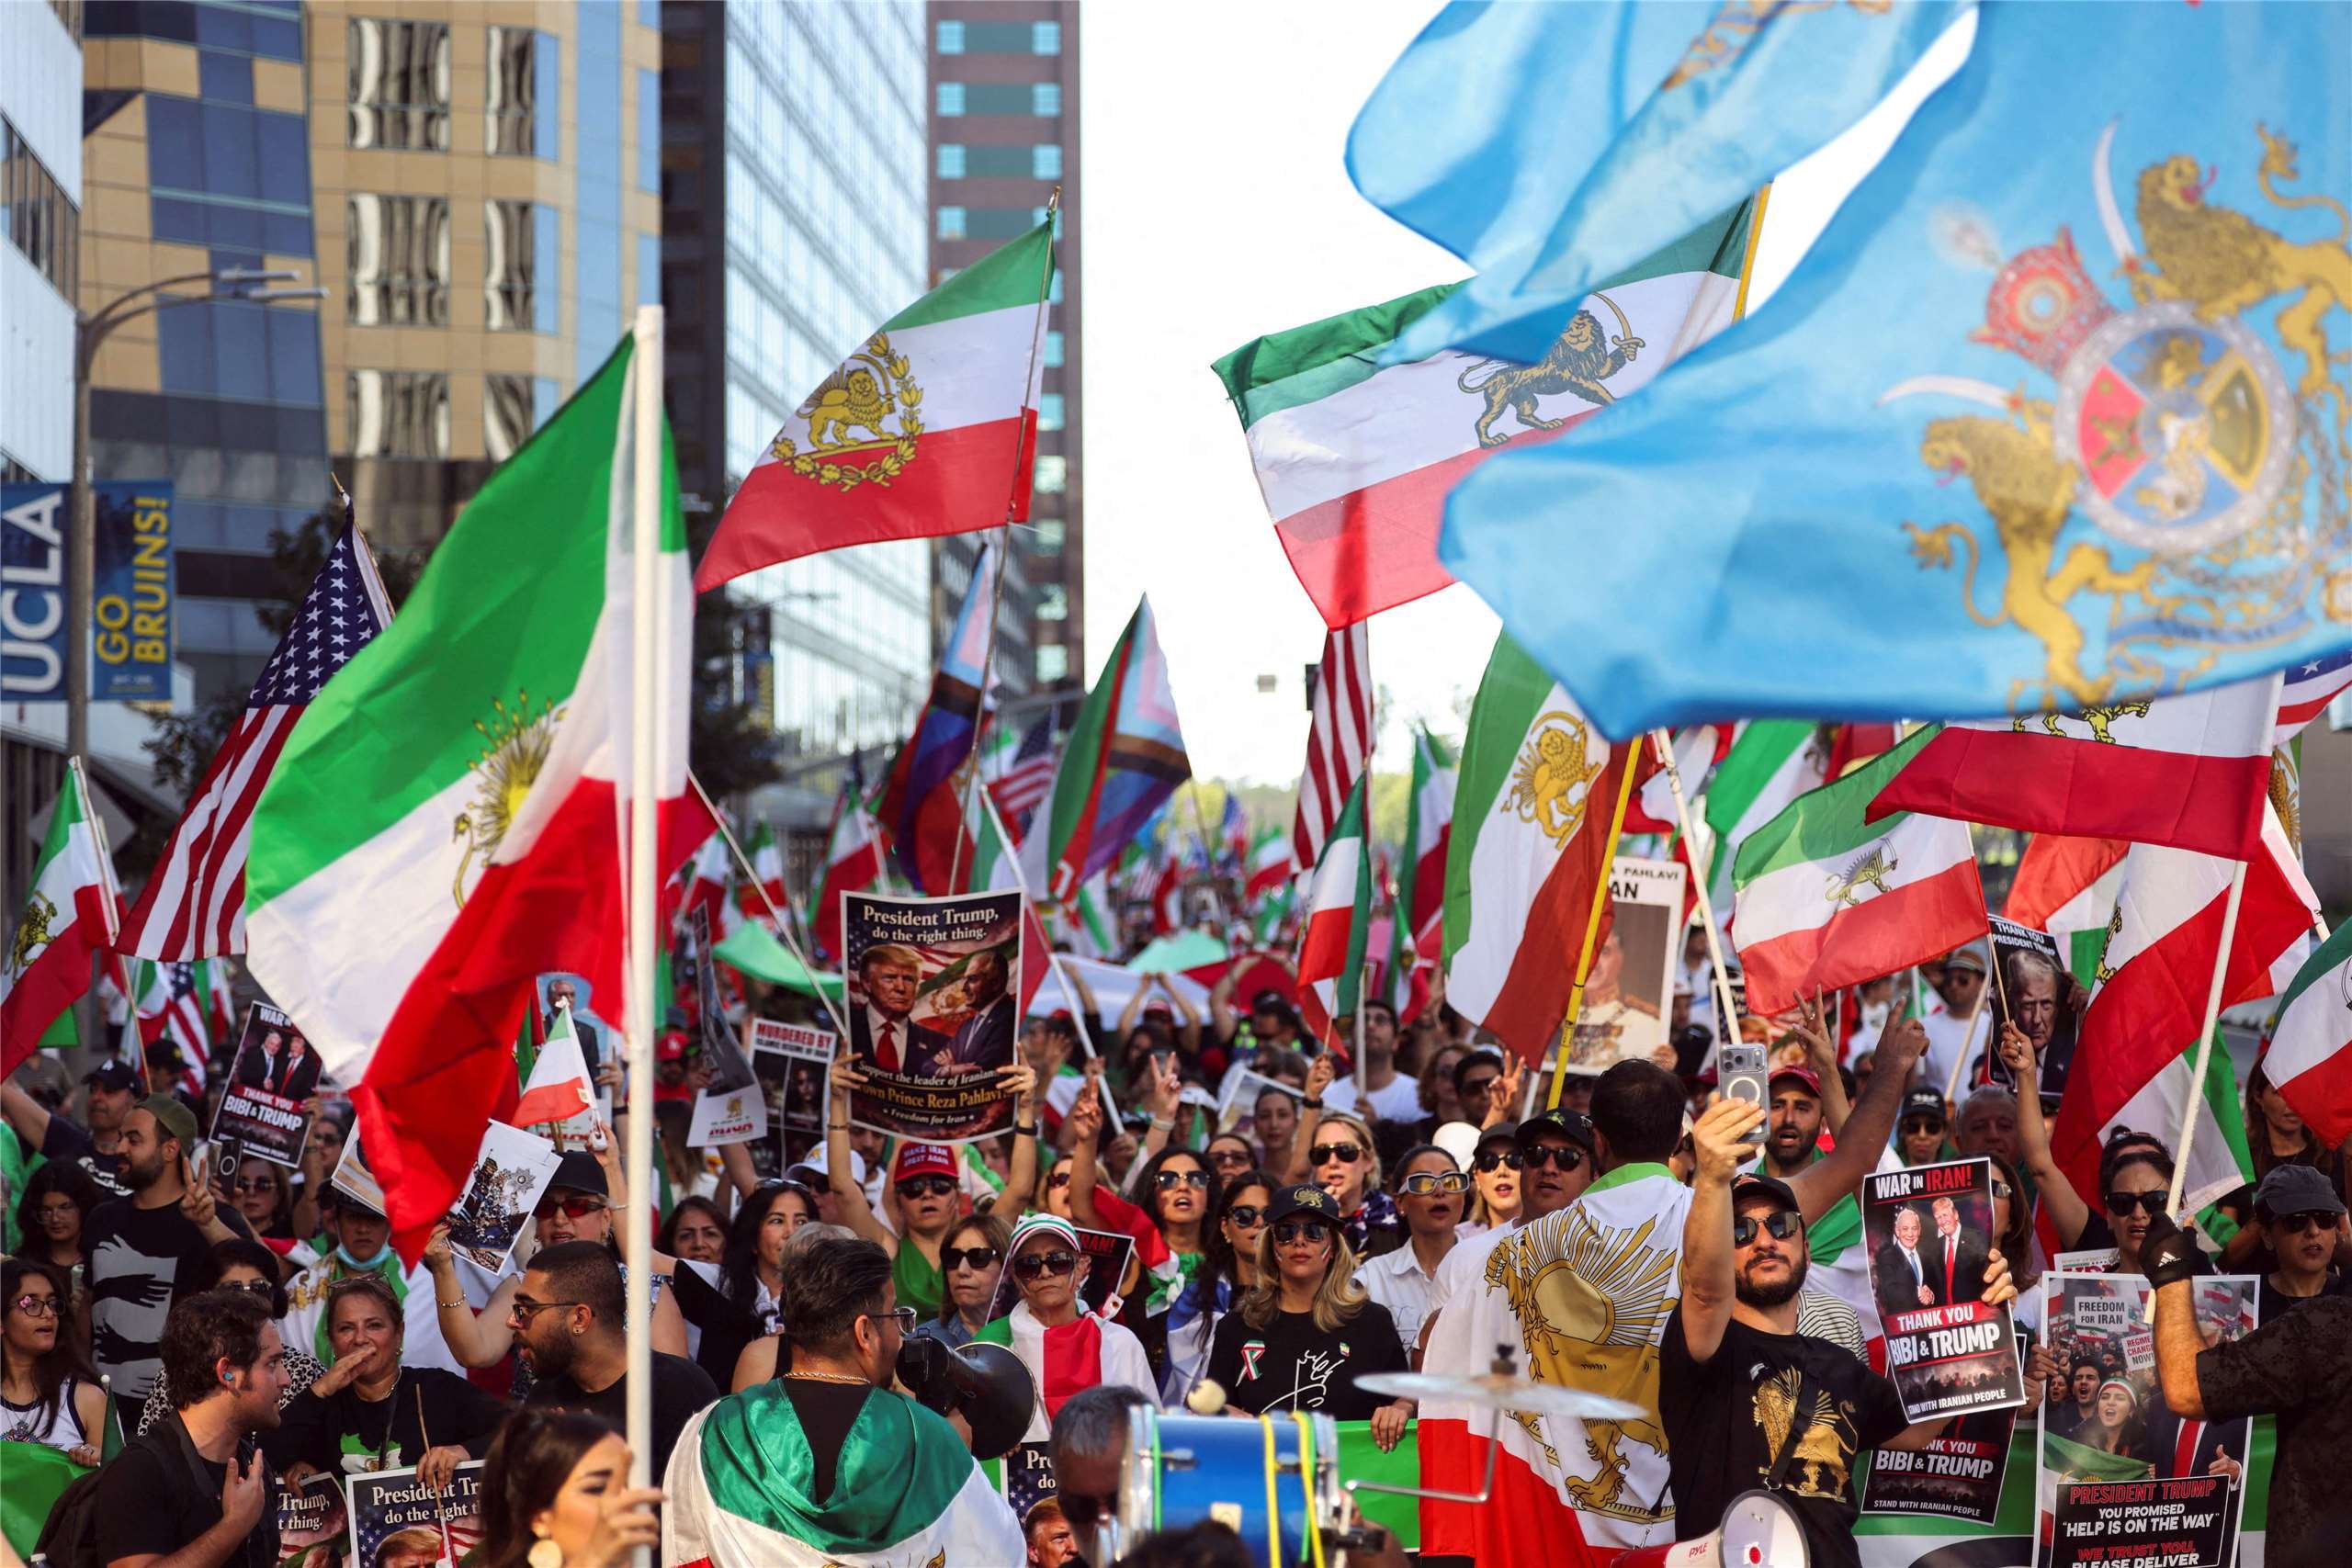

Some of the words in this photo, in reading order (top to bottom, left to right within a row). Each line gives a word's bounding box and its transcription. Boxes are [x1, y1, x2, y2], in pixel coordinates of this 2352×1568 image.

[132, 496, 169, 664] BRUINS!
[0, 490, 62, 694] UCLA
[95, 594, 130, 664] GO
[1623, 866, 1679, 880] PAHLAVI
[863, 904, 940, 927] President
[942, 908, 1000, 925] Trump,
[872, 927, 888, 940] do
[892, 930, 913, 942] the
[916, 931, 948, 945] right
[951, 927, 988, 941] thing.
[1995, 921, 2028, 939] THANK
[2027, 930, 2046, 944] YOU
[1992, 933, 2034, 950] PRESIDENT
[2033, 942, 2056, 956] TRUMP
[258, 1007, 285, 1028] WAR
[756, 1022, 815, 1046] MURDERED
[817, 1033, 833, 1049] BY
[896, 1071, 912, 1085] the
[913, 1074, 946, 1087] leader
[946, 1074, 959, 1089] of
[242, 1087, 274, 1102] THANK
[276, 1096, 295, 1110] YOU
[859, 1084, 886, 1100] rown
[887, 1087, 925, 1108] Prince
[927, 1092, 957, 1109] Reza
[223, 1094, 250, 1118] BIBI
[250, 1107, 258, 1118] &
[257, 1104, 303, 1132] TRUMP
[889, 1107, 930, 1124] Freedom
[929, 1113, 945, 1126] for
[945, 1113, 967, 1125] Iran
[1875, 1173, 1912, 1199] WAR
[1913, 1175, 1924, 1190] IN
[1925, 1165, 1973, 1192] IRAN!
[1896, 1310, 1943, 1332] THANK
[1944, 1304, 1974, 1324] YOU
[2078, 1301, 2126, 1313] FREEDOM
[2080, 1314, 2096, 1324] FOR
[2097, 1314, 2124, 1325] IRAN
[1888, 1335, 1919, 1366] BIBI
[1919, 1340, 1929, 1357] &
[1928, 1322, 2001, 1359] TRUMP
[2126, 1336, 2152, 1348] REGIME
[1920, 1400, 1938, 1413] WITH
[1938, 1393, 1973, 1409] IRANIAN
[1974, 1388, 2007, 1404] PEOPLE
[1949, 1440, 1977, 1455] YOU
[1875, 1450, 1915, 1472] BIBI
[1914, 1457, 1925, 1470] &
[1926, 1453, 1995, 1480] TRUMP
[1037, 1473, 1057, 1489] do
[277, 1492, 331, 1512] Trump,
[2069, 1483, 2157, 1506] PRESIDENT
[2161, 1479, 2218, 1500] TRUMP
[384, 1509, 403, 1525] do
[406, 1506, 430, 1522] the
[434, 1502, 469, 1522] right
[1873, 1499, 1898, 1509] STAND
[1898, 1500, 1919, 1510] WITH
[1919, 1501, 1952, 1512] IRANIAN
[1952, 1505, 1982, 1517] PEOPLE
[2098, 1506, 2123, 1520] YOU
[2124, 1503, 2186, 1518] PROMISED
[288, 1516, 323, 1532] thing.
[2107, 1520, 2121, 1535] IS
[2124, 1518, 2148, 1534] ON
[2150, 1516, 2179, 1532] THE
[2076, 1547, 2105, 1562] WE
[2107, 1543, 2159, 1560] TRUST
[2160, 1540, 2197, 1555] YOU.
[2133, 1552, 2200, 1567] DELIVER
